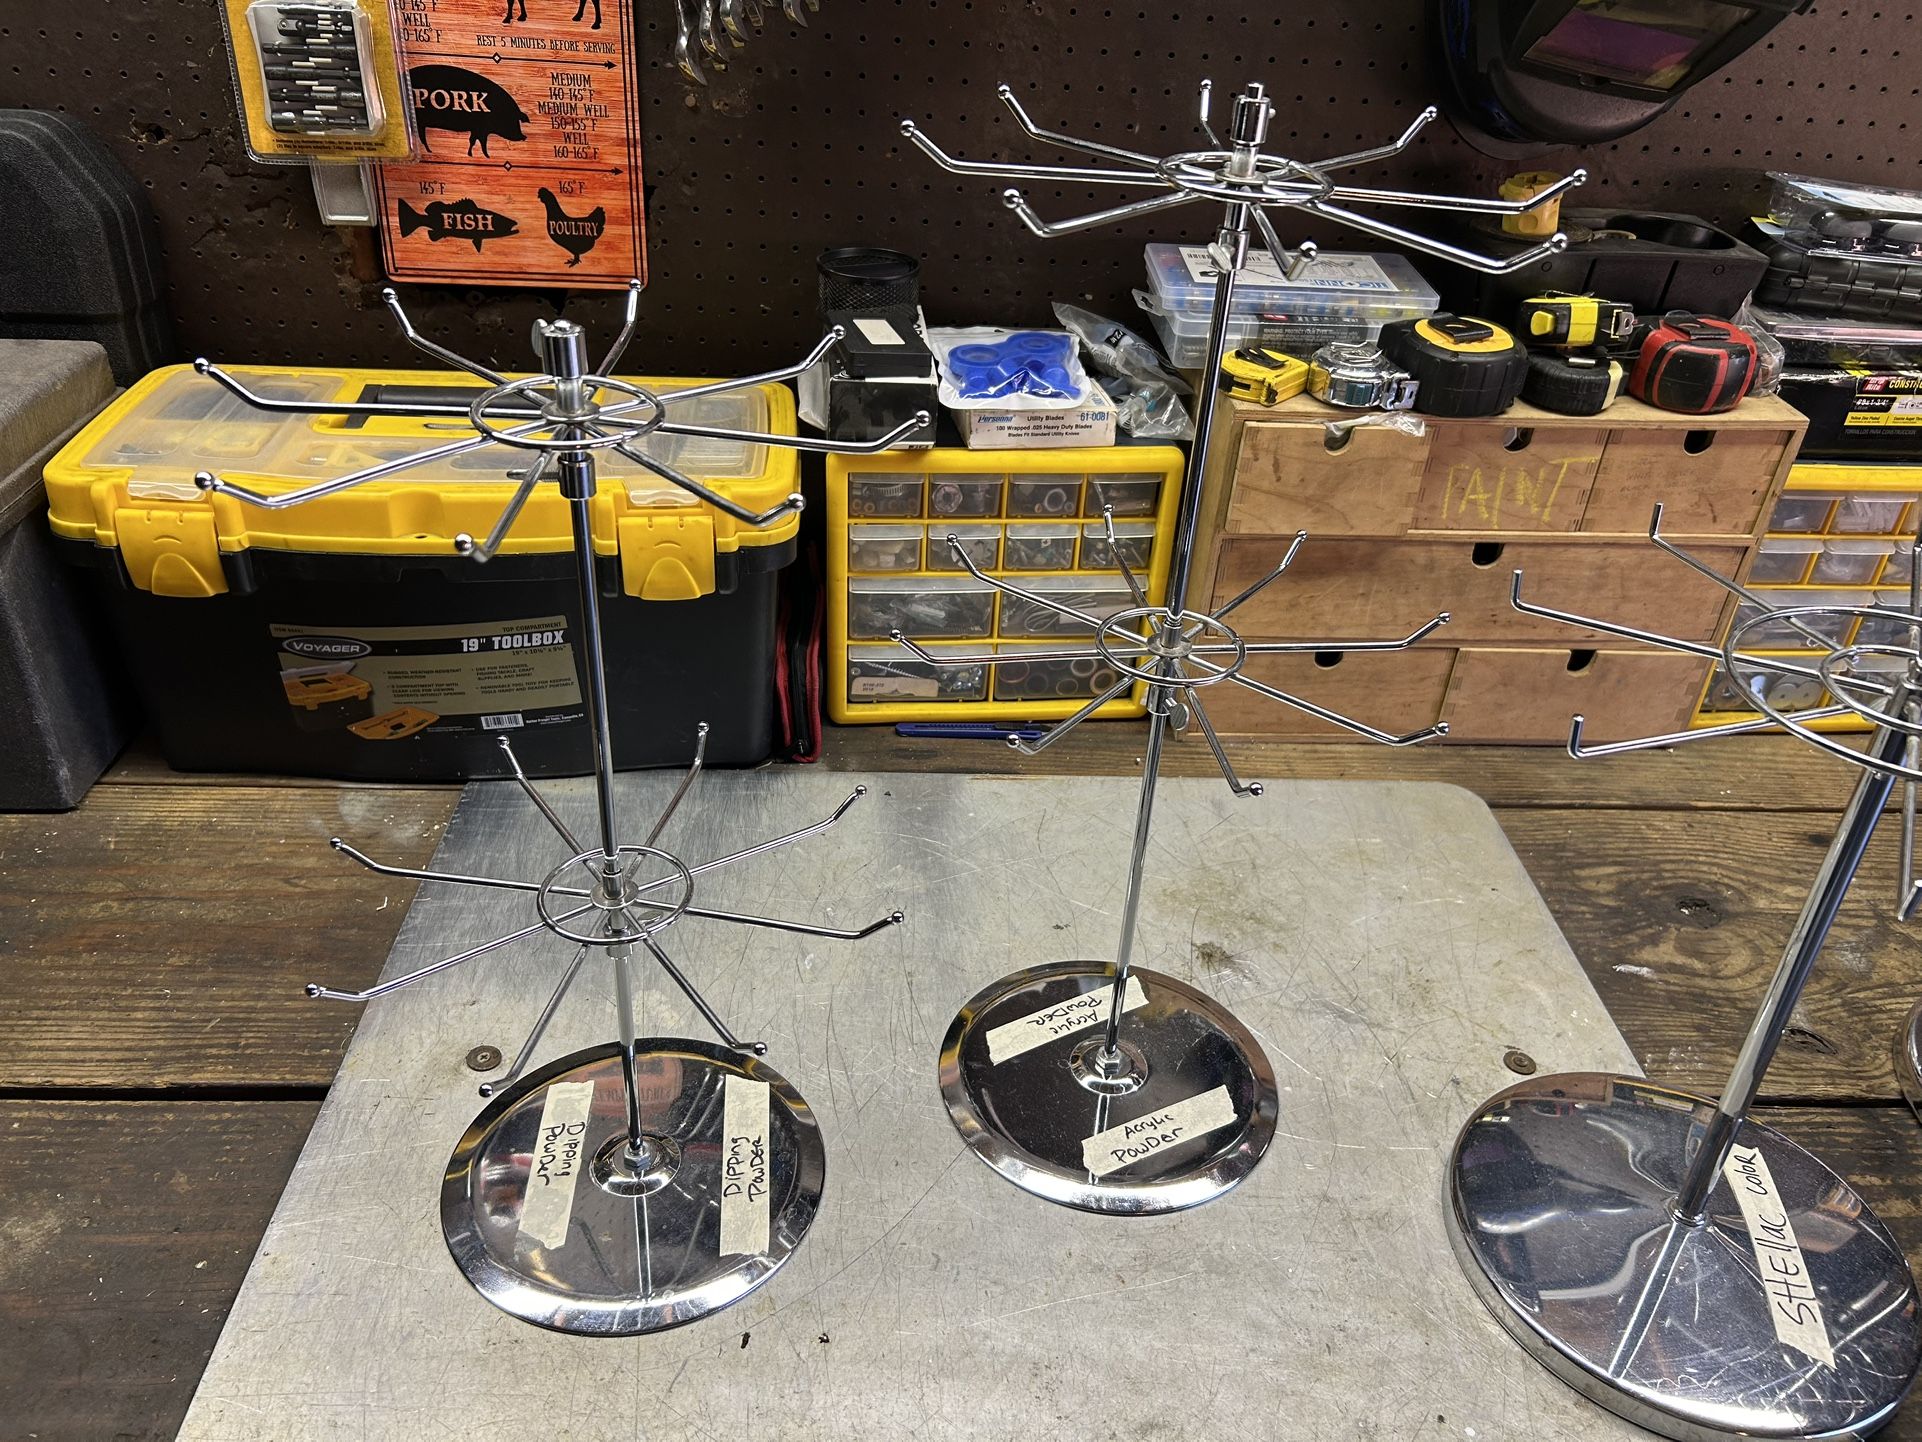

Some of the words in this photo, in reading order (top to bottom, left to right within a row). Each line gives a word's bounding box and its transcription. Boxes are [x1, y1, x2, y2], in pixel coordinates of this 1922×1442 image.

[402, 12, 431, 27] WELL
[436, 30, 442, 43] F
[476, 35, 496, 47] REST
[501, 37, 506, 47] 5
[510, 37, 546, 49] MINUTES
[550, 39, 580, 52] BEFORE
[583, 41, 616, 54] SERVING
[551, 72, 592, 87] MEDIUM
[413, 88, 491, 113] PORK
[589, 90, 595, 102] F
[537, 101, 579, 116] MEDIUM
[584, 104, 609, 118] WELL
[592, 119, 598, 131] F
[563, 132, 589, 145] WELL
[593, 147, 600, 160] F
[439, 182, 446, 194] F
[578, 181, 585, 194] F
[441, 212, 495, 231] FISH
[550, 220, 599, 237] POULTRY
[1080, 412, 1109, 422] 61-0081
[1441, 456, 1599, 530] PAINT
[516, 622, 562, 632] COMPARTMENT
[293, 641, 360, 653] VOYAGER
[460, 637, 486, 653] 19"
[492, 630, 565, 650] TOOLBOX
